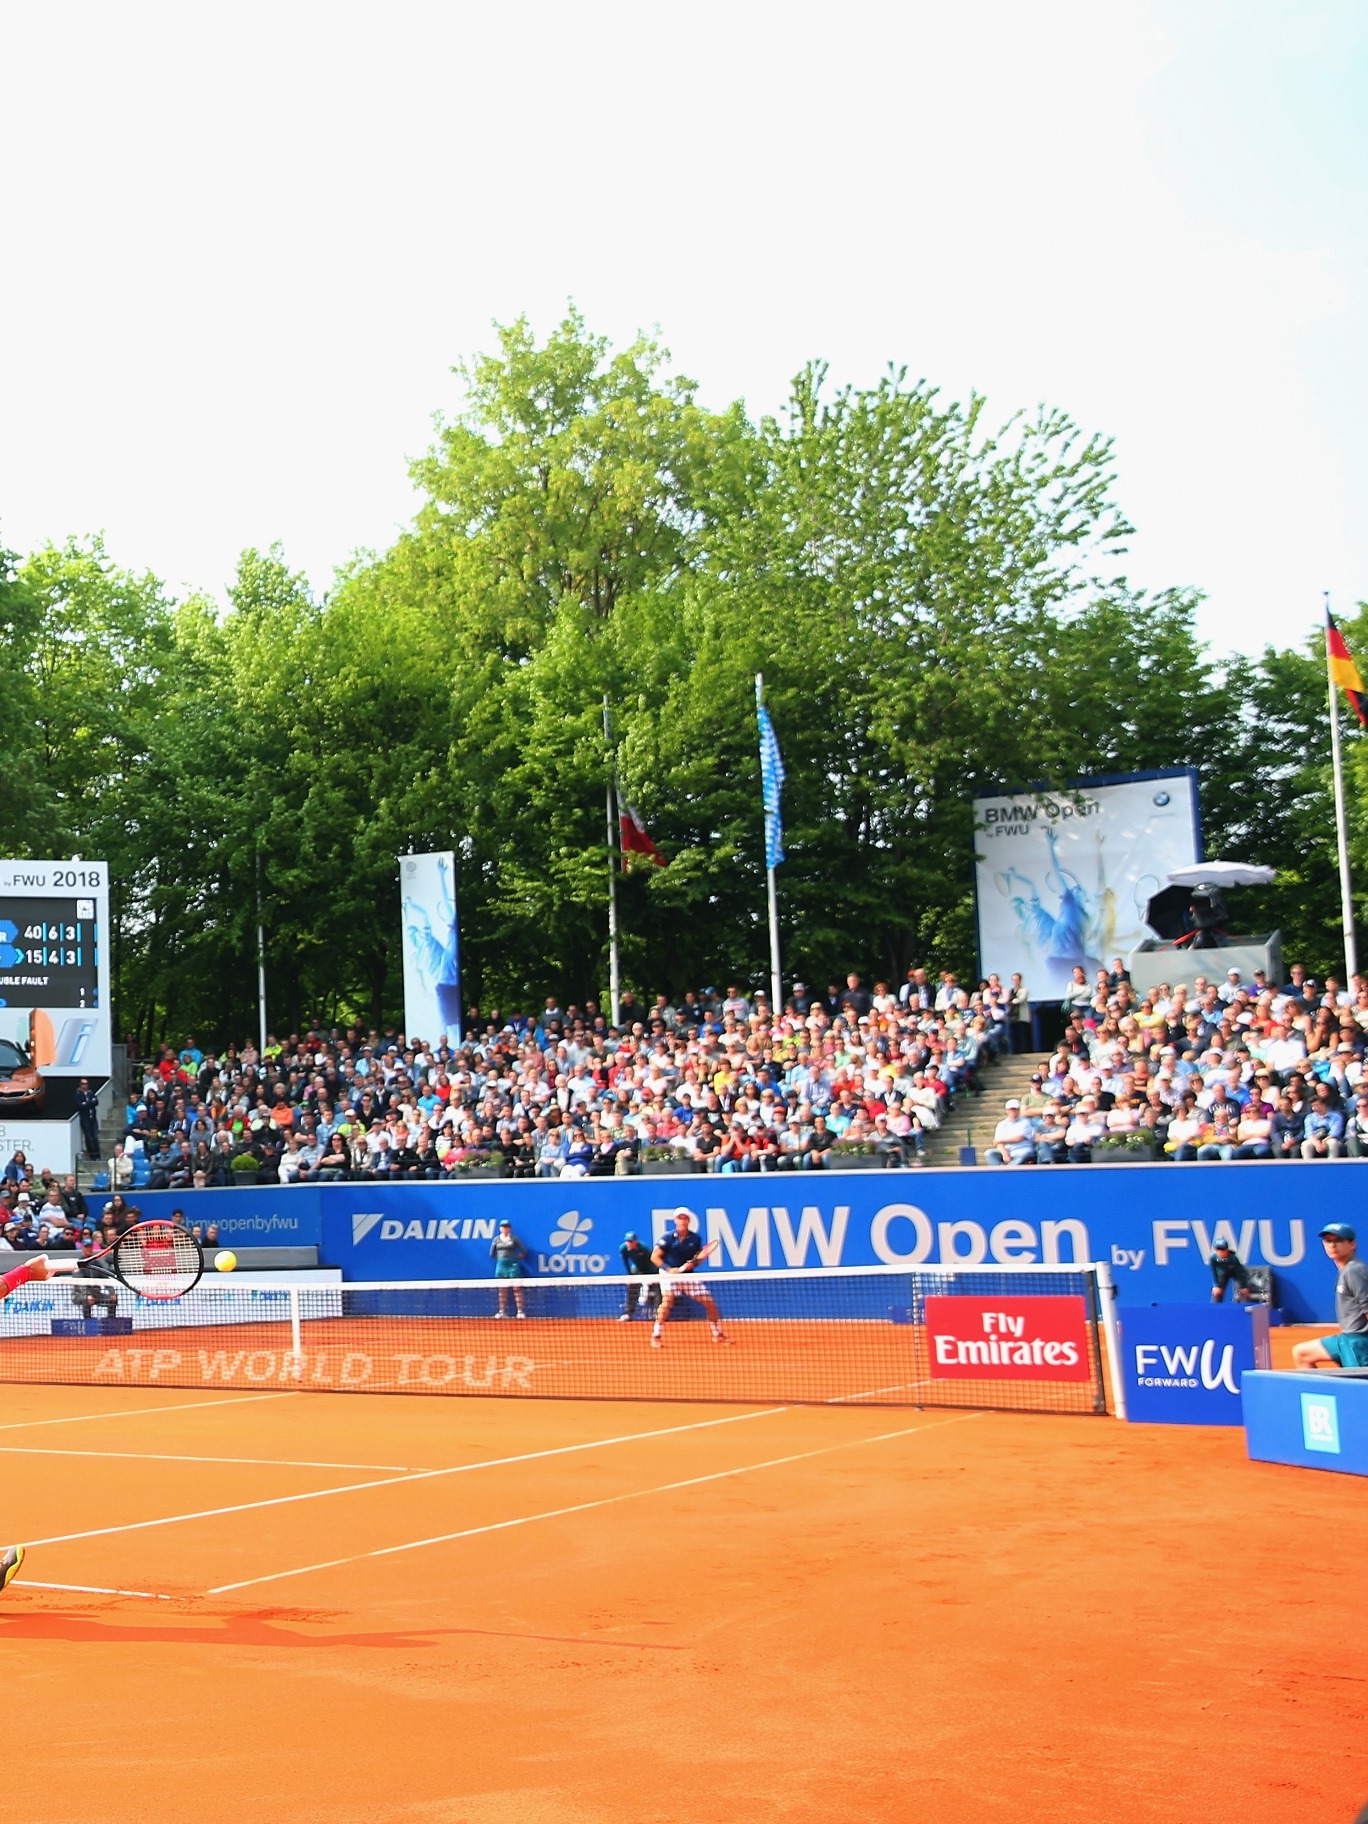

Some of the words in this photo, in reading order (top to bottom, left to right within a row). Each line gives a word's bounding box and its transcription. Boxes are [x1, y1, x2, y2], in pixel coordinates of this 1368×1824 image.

[995, 824, 1029, 837] FWU
[13, 875, 46, 886] FWU
[53, 871, 101, 887] 2018
[24, 926, 42, 939] 40
[48, 926, 58, 939] 6
[66, 926, 76, 940] 3
[26, 950, 42, 964] 15
[48, 951, 59, 964] 4
[66, 950, 76, 964] 3
[21, 976, 49, 986] FAULT
[380, 1219, 496, 1241] DAIKIN
[870, 1203, 1089, 1272] Open
[1111, 1243, 1145, 1270] by
[1151, 1219, 1306, 1267] FWU
[537, 1253, 606, 1273] LOTTO
[982, 1311, 1025, 1337] Fly
[933, 1334, 1080, 1366] Emirates
[92, 1348, 182, 1379] ATP
[197, 1350, 373, 1383] WORLD
[392, 1353, 532, 1388] TOUR
[1135, 1339, 1241, 1394] FWU
[1137, 1377, 1199, 1388] FORWARD
